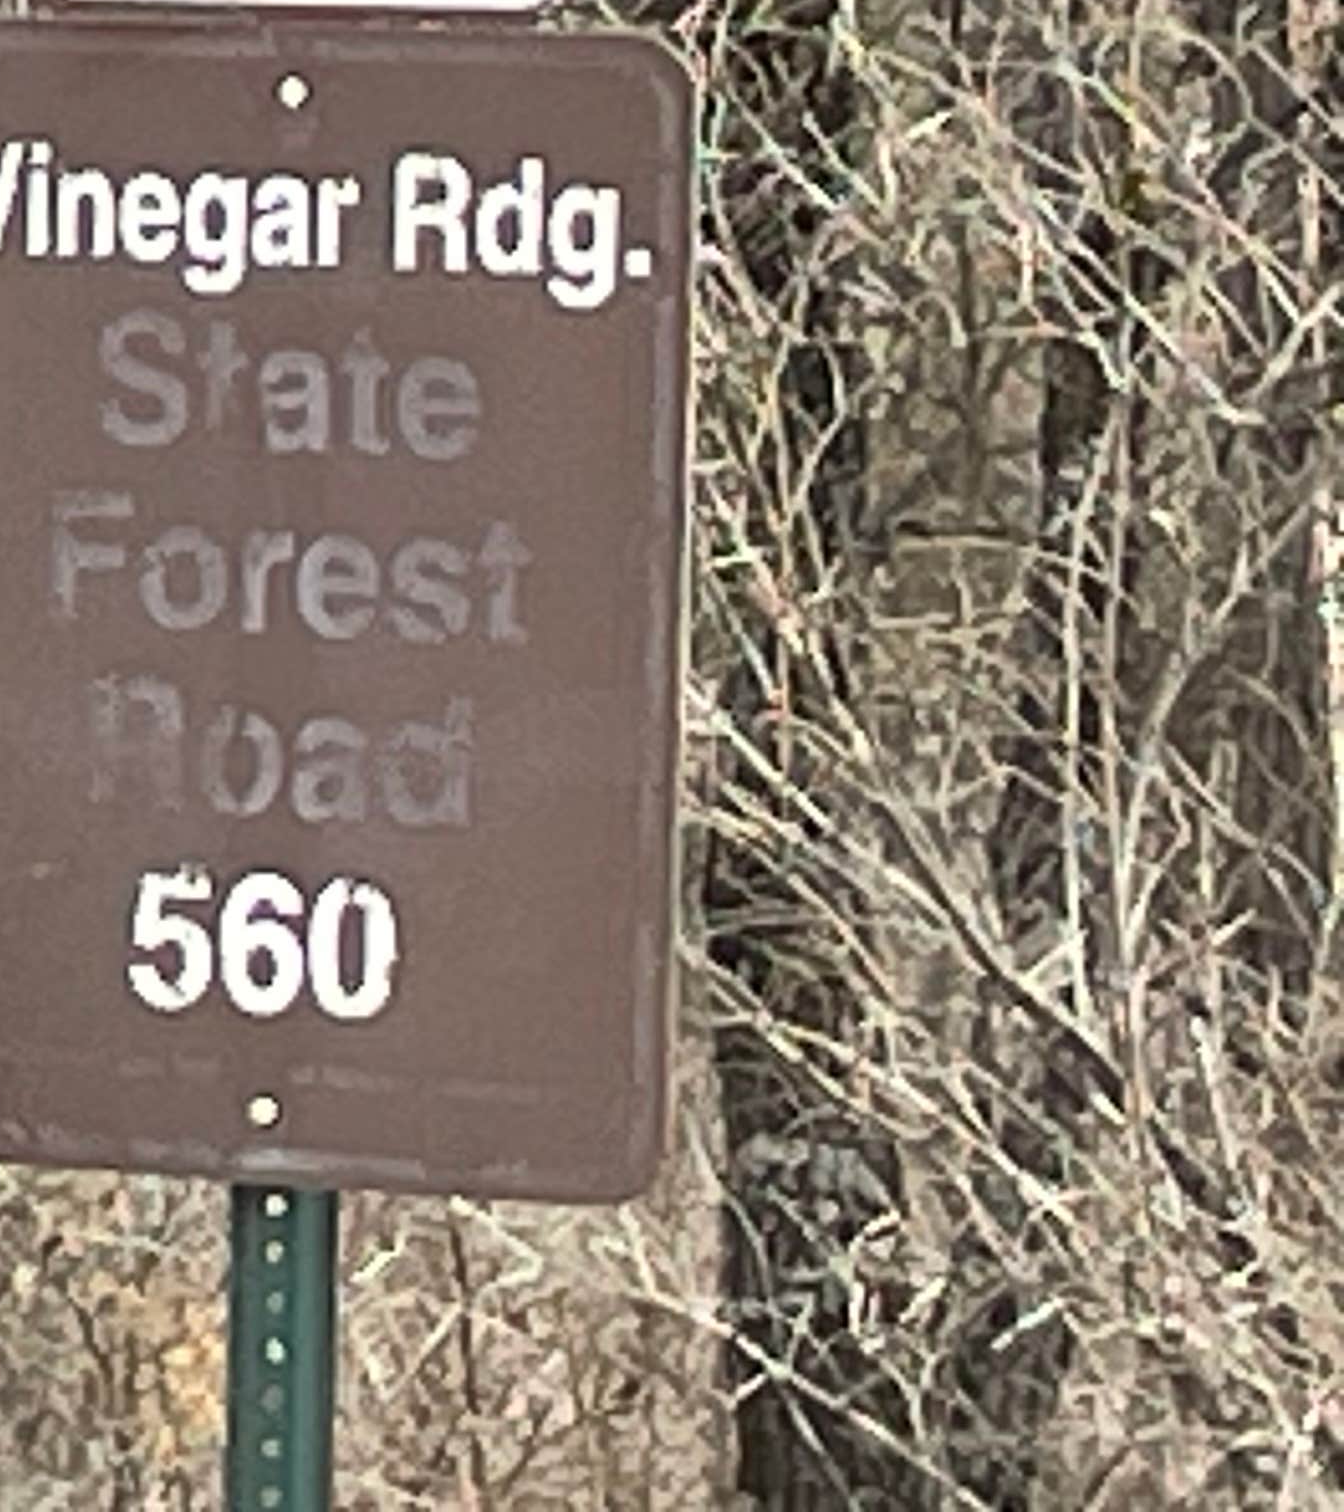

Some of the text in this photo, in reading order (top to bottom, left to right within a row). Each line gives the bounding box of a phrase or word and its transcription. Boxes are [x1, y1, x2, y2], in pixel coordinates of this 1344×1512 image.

[392, 153, 652, 309] Rdg.
[99, 308, 483, 461] State
[49, 491, 533, 644] Forest
[127, 866, 399, 1020] 560
